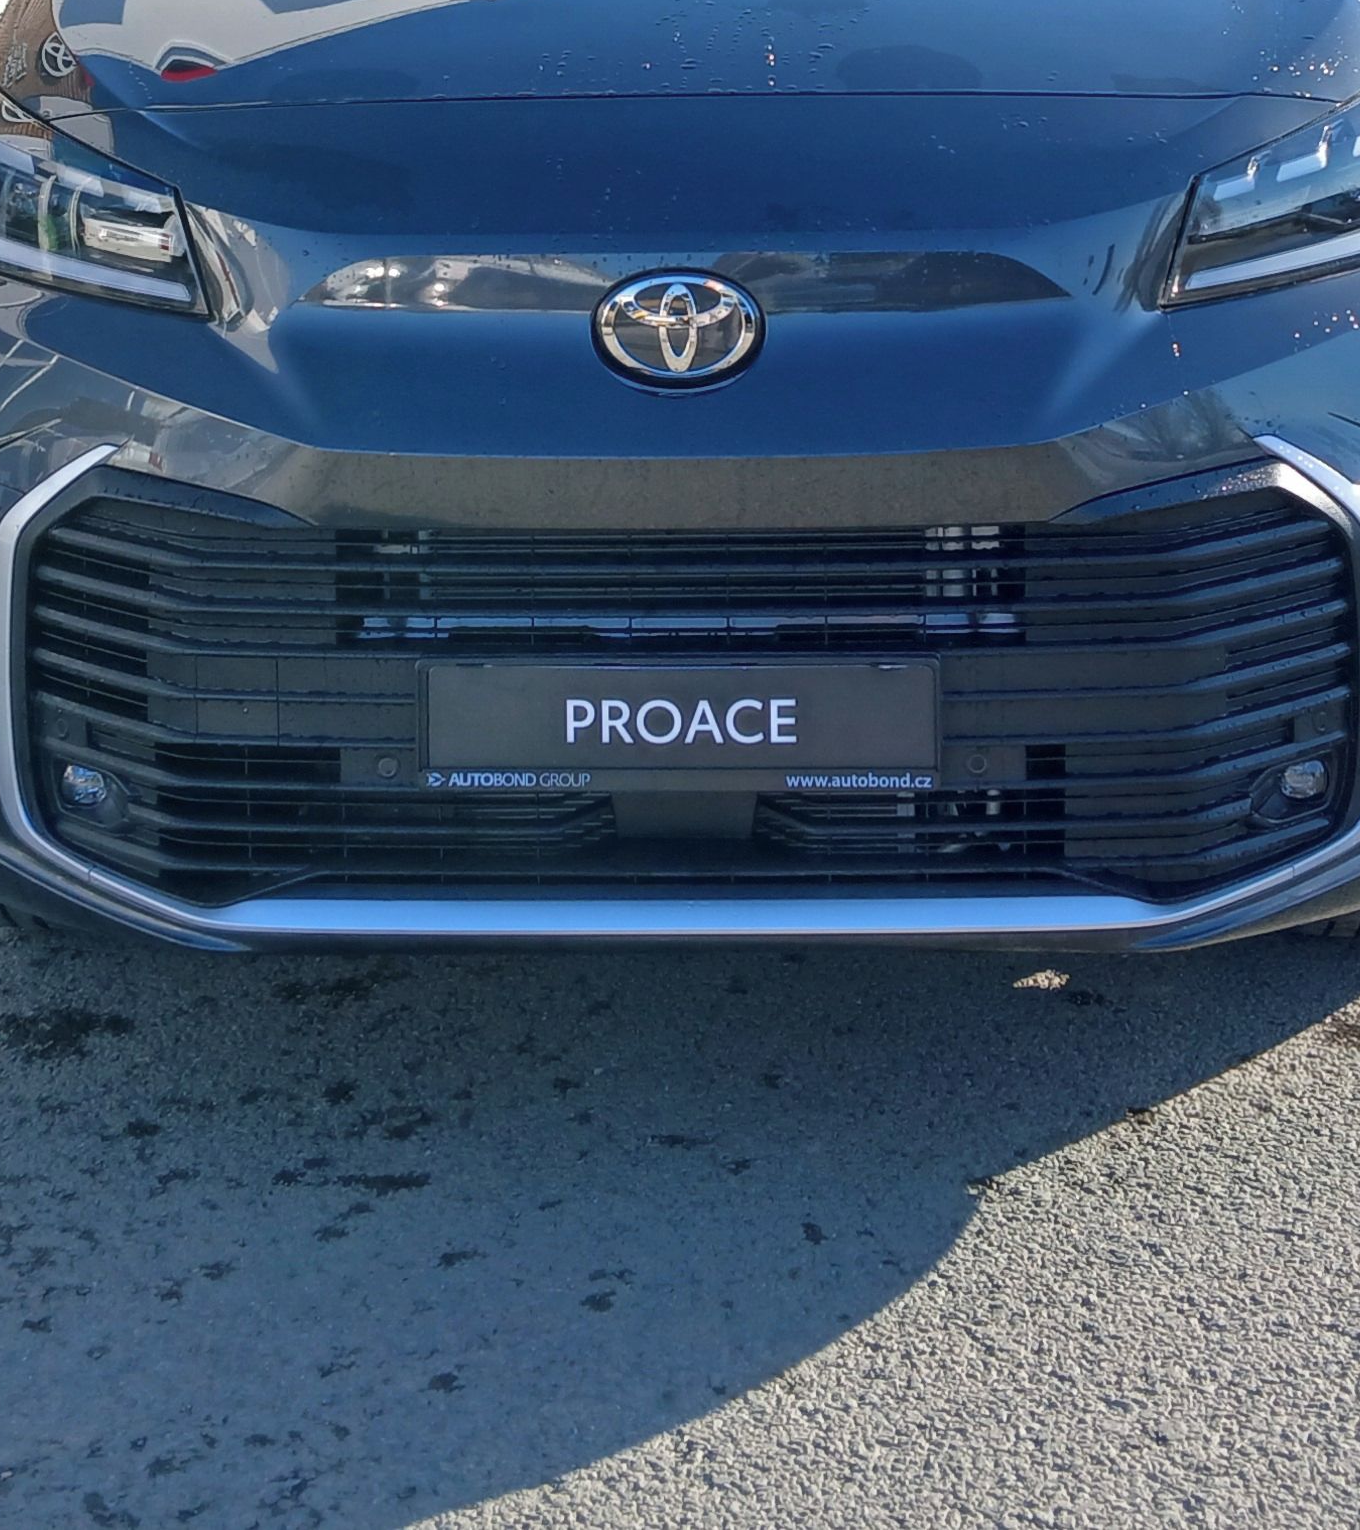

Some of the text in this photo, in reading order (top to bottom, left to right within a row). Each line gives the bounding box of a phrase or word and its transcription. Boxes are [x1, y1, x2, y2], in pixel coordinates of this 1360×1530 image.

[564, 698, 798, 744] PROACE
[448, 772, 591, 788] AUTOBOND GROUP
[785, 773, 934, 790] www.autobond.cz
